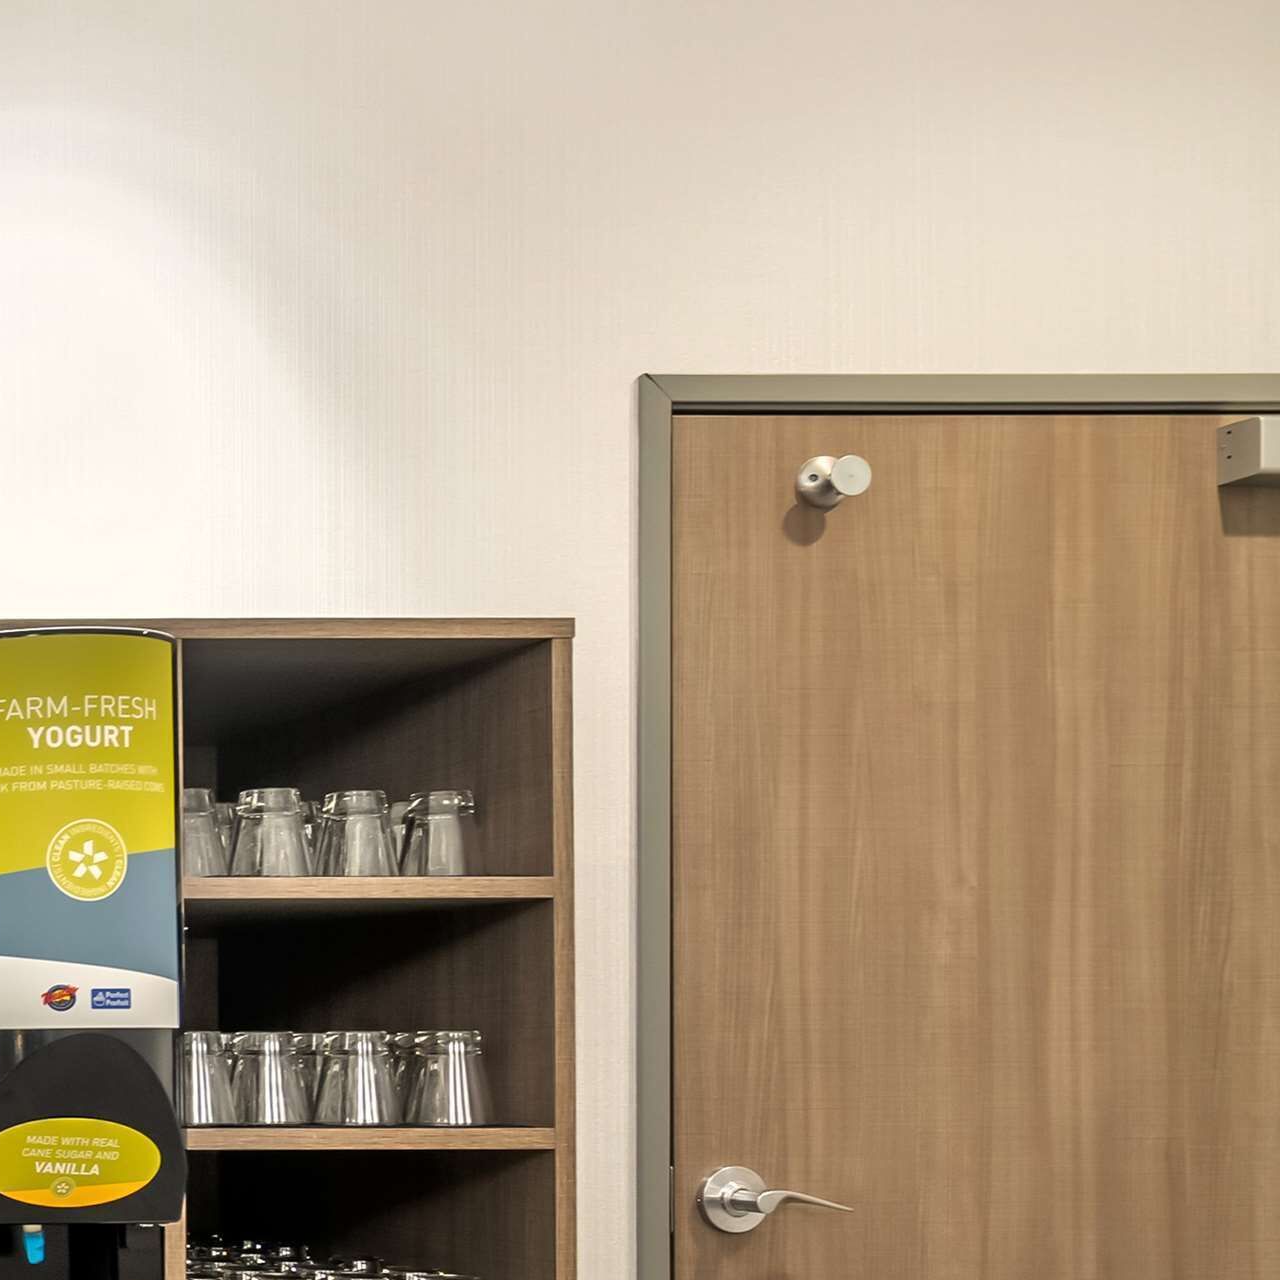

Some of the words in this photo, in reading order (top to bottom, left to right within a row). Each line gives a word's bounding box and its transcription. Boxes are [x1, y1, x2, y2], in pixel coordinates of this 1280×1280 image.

[26, 724, 134, 749] YOGURT
[30, 764, 44, 776] IN
[46, 763, 87, 775] SMALL
[89, 763, 137, 775] BATCHES
[12, 780, 48, 792] FROM
[50, 779, 143, 792] PASTURE-RAISED
[25, 1135, 59, 1146] MADE
[60, 1136, 90, 1147] WITH
[91, 1137, 121, 1149] REAL
[21, 1147, 53, 1158] CANE
[55, 1149, 93, 1160] SUGAR
[94, 1151, 121, 1161] AND
[34, 1161, 101, 1176] VANILLA
